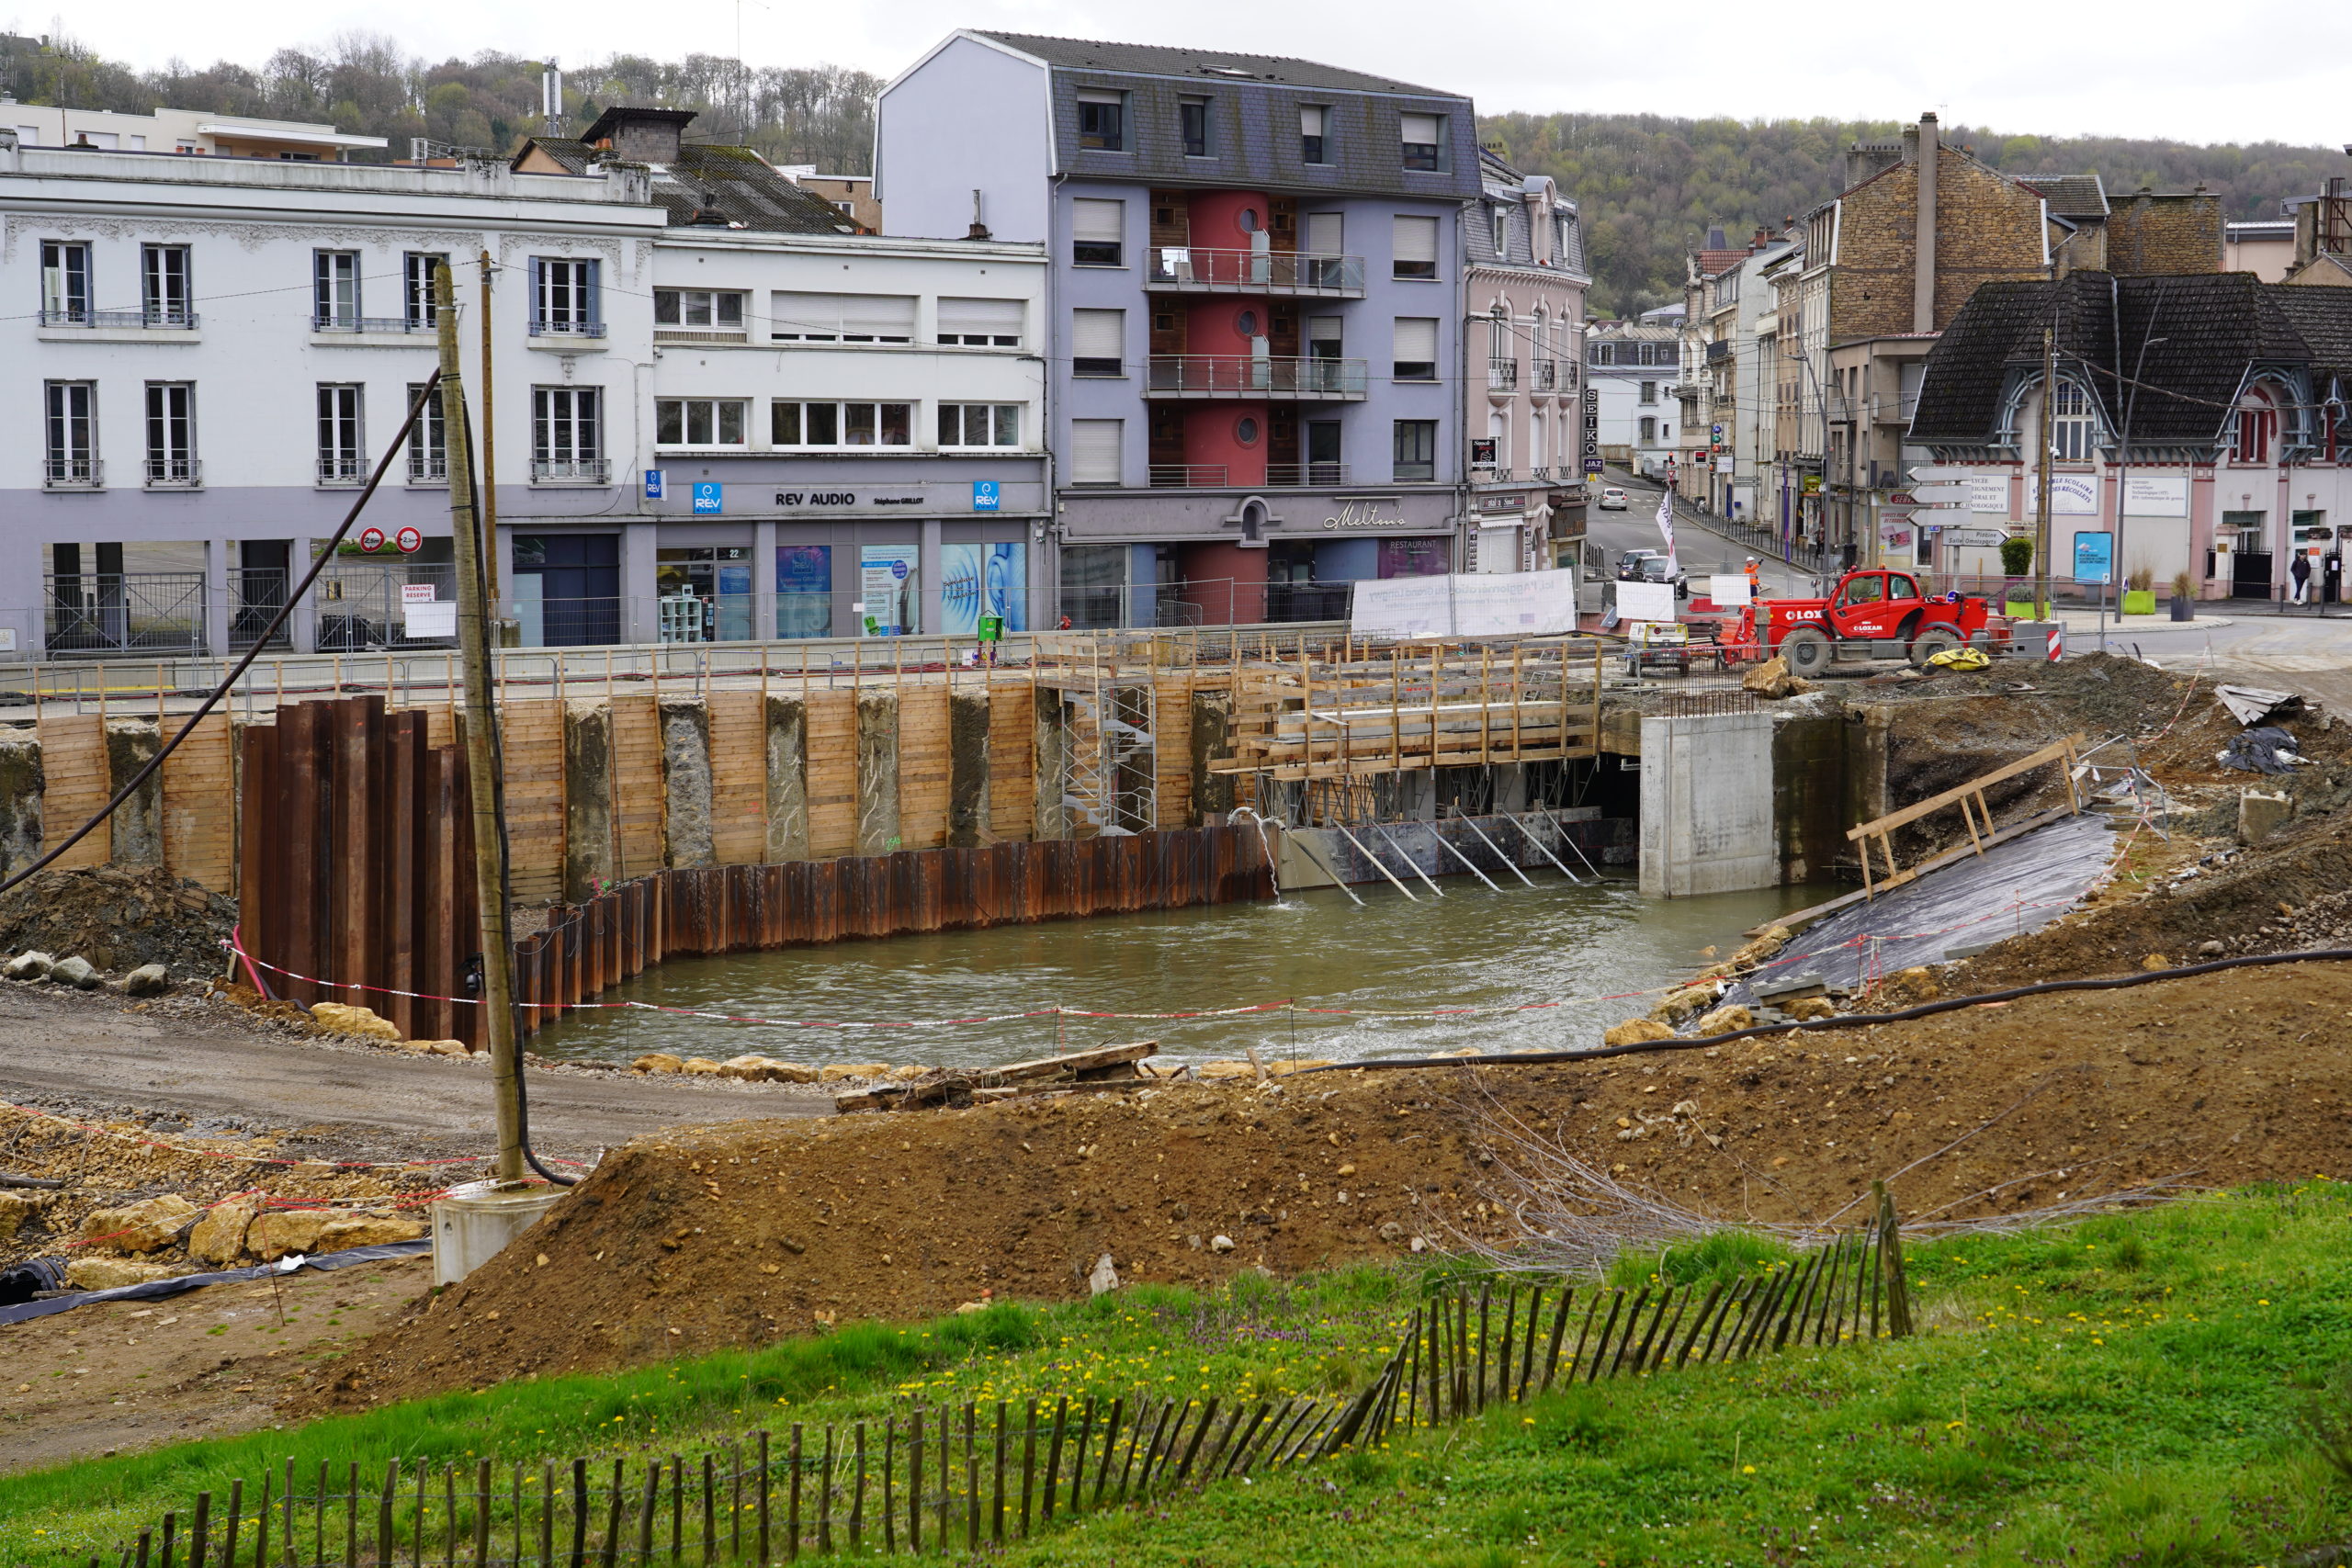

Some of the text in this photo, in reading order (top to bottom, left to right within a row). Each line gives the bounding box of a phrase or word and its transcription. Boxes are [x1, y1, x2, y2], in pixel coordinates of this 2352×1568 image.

[1587, 390, 1597, 454] SEIKO
[647, 483, 661, 492] REV
[2064, 478, 2094, 495] SCOLAIRE
[2062, 485, 2092, 503] RÉCOLLETS
[695, 498, 721, 508] REV
[775, 493, 804, 505] REV
[809, 493, 855, 505] AUDIO
[874, 497, 900, 506] Stéphane
[976, 495, 999, 505] REV
[1323, 499, 1407, 530] Melton's
[1390, 539, 1437, 549] RESTAURANT
[729, 549, 740, 558] 22
[1796, 611, 1824, 619] LOX
